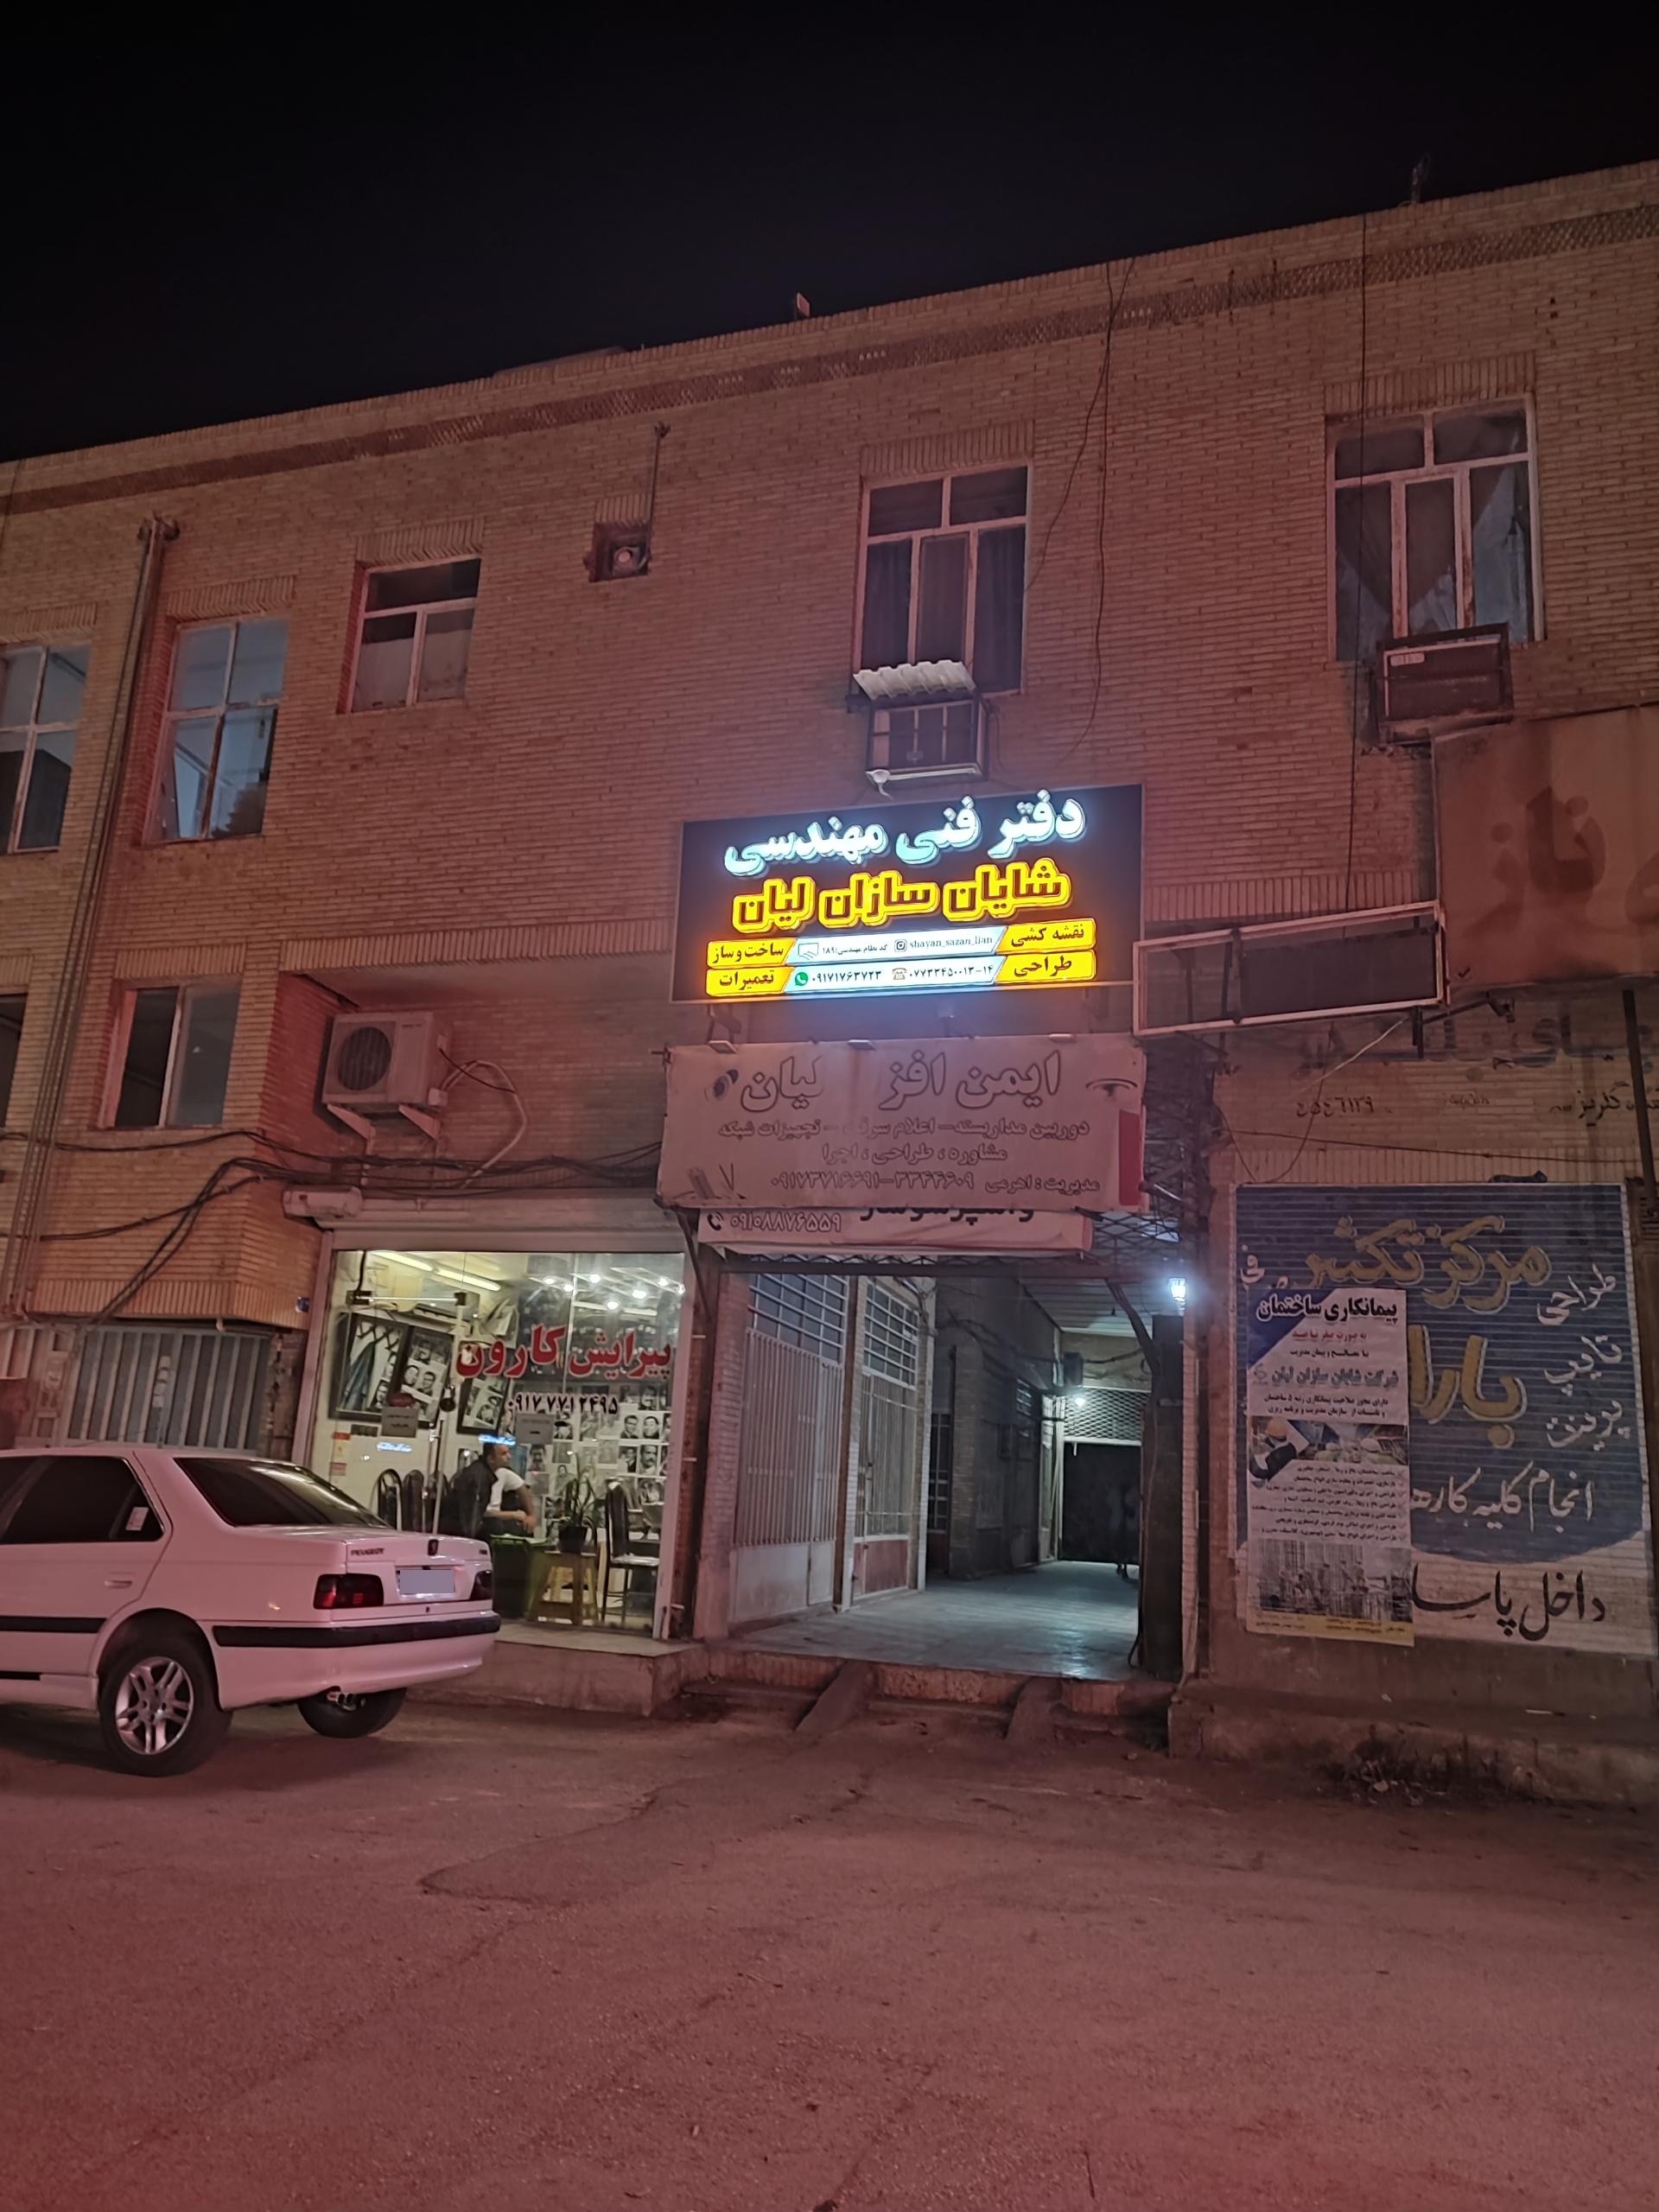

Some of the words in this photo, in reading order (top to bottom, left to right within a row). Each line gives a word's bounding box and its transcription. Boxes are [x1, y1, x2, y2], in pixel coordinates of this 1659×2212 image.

[724, 816, 887, 876] مهندسی
[896, 795, 982, 863] فنی
[988, 790, 1086, 858] دفتر
[732, 874, 815, 933] لیان
[818, 869, 940, 928] سازان
[943, 856, 1071, 922] شایان
[712, 946, 734, 963] ساز
[744, 943, 784, 958] ساخت
[1011, 927, 1047, 947] کشی
[1052, 924, 1085, 940] نقشه
[719, 969, 775, 990] تعمیرات
[1014, 957, 1072, 977] طراحی
[741, 1054, 825, 1113] لیان
[956, 1050, 1061, 1109] ایمن
[718, 1120, 755, 1141] شبکه
[757, 1119, 822, 1141] تجهیزات
[893, 1117, 936, 1139] اعلام
[1029, 1121, 1090, 1141] دوربین
[822, 1142, 858, 1166] اجرا
[871, 1141, 934, 1166] طراحی
[948, 1143, 1008, 1166] مشاوره
[1044, 1176, 1101, 1195] مدیریت
[729, 1211, 842, 1233] ۰۹۱۰۸۸۷۶۵۵۹
[1421, 1215, 1553, 1315] مرکز
[1256, 1293, 1322, 1323] ساختمان
[1324, 1297, 1399, 1324] پیمانکاری
[1536, 1262, 1617, 1326] طراحی
[455, 1324, 567, 1378] کارون
[568, 1331, 673, 1380] پیرایش
[1543, 1334, 1623, 1397] تایپ
[1408, 1325, 1528, 1450] بارا
[1545, 1399, 1631, 1452] پرینت
[1410, 1466, 1482, 1514] کاره
[1472, 1459, 1535, 1530] کلیه
[1529, 1468, 1595, 1535] انجام
[1411, 1562, 1517, 1637] پاسا
[1519, 1569, 1605, 1642] داخل
